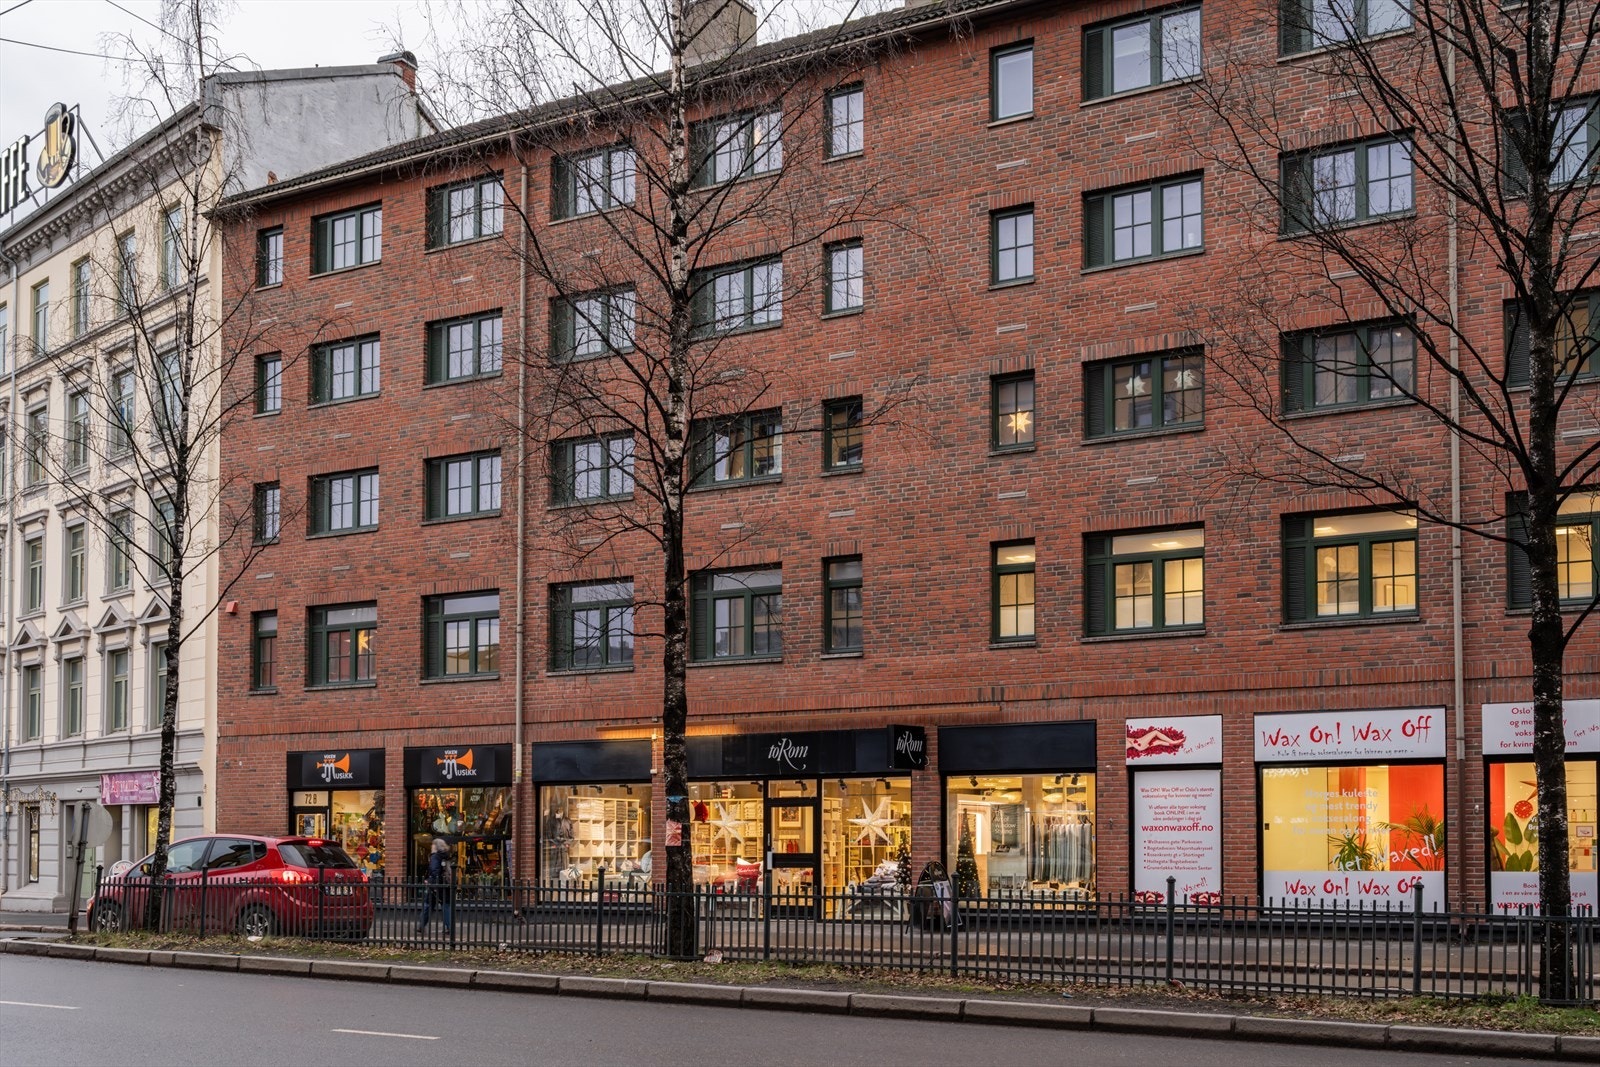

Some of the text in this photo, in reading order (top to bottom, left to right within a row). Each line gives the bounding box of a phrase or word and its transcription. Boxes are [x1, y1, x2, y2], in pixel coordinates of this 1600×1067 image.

[0, 135, 29, 217] FFE
[1512, 707, 1534, 715] Oslo'
[1510, 720, 1519, 728] og
[1262, 715, 1432, 747] Wax On! Wax Off
[896, 731, 923, 764] toRom
[768, 738, 808, 771] toRom
[1342, 788, 1378, 798] kuleste
[304, 794, 313, 804] 72
[1345, 801, 1378, 812] trendy
[1141, 822, 1214, 832] waxonwaxoff.no
[1340, 828, 1352, 838] og
[1331, 833, 1438, 874] Get Waxed!
[1285, 879, 1316, 896] Wax
[1323, 877, 1349, 896] On!
[1358, 878, 1389, 896] Wax
